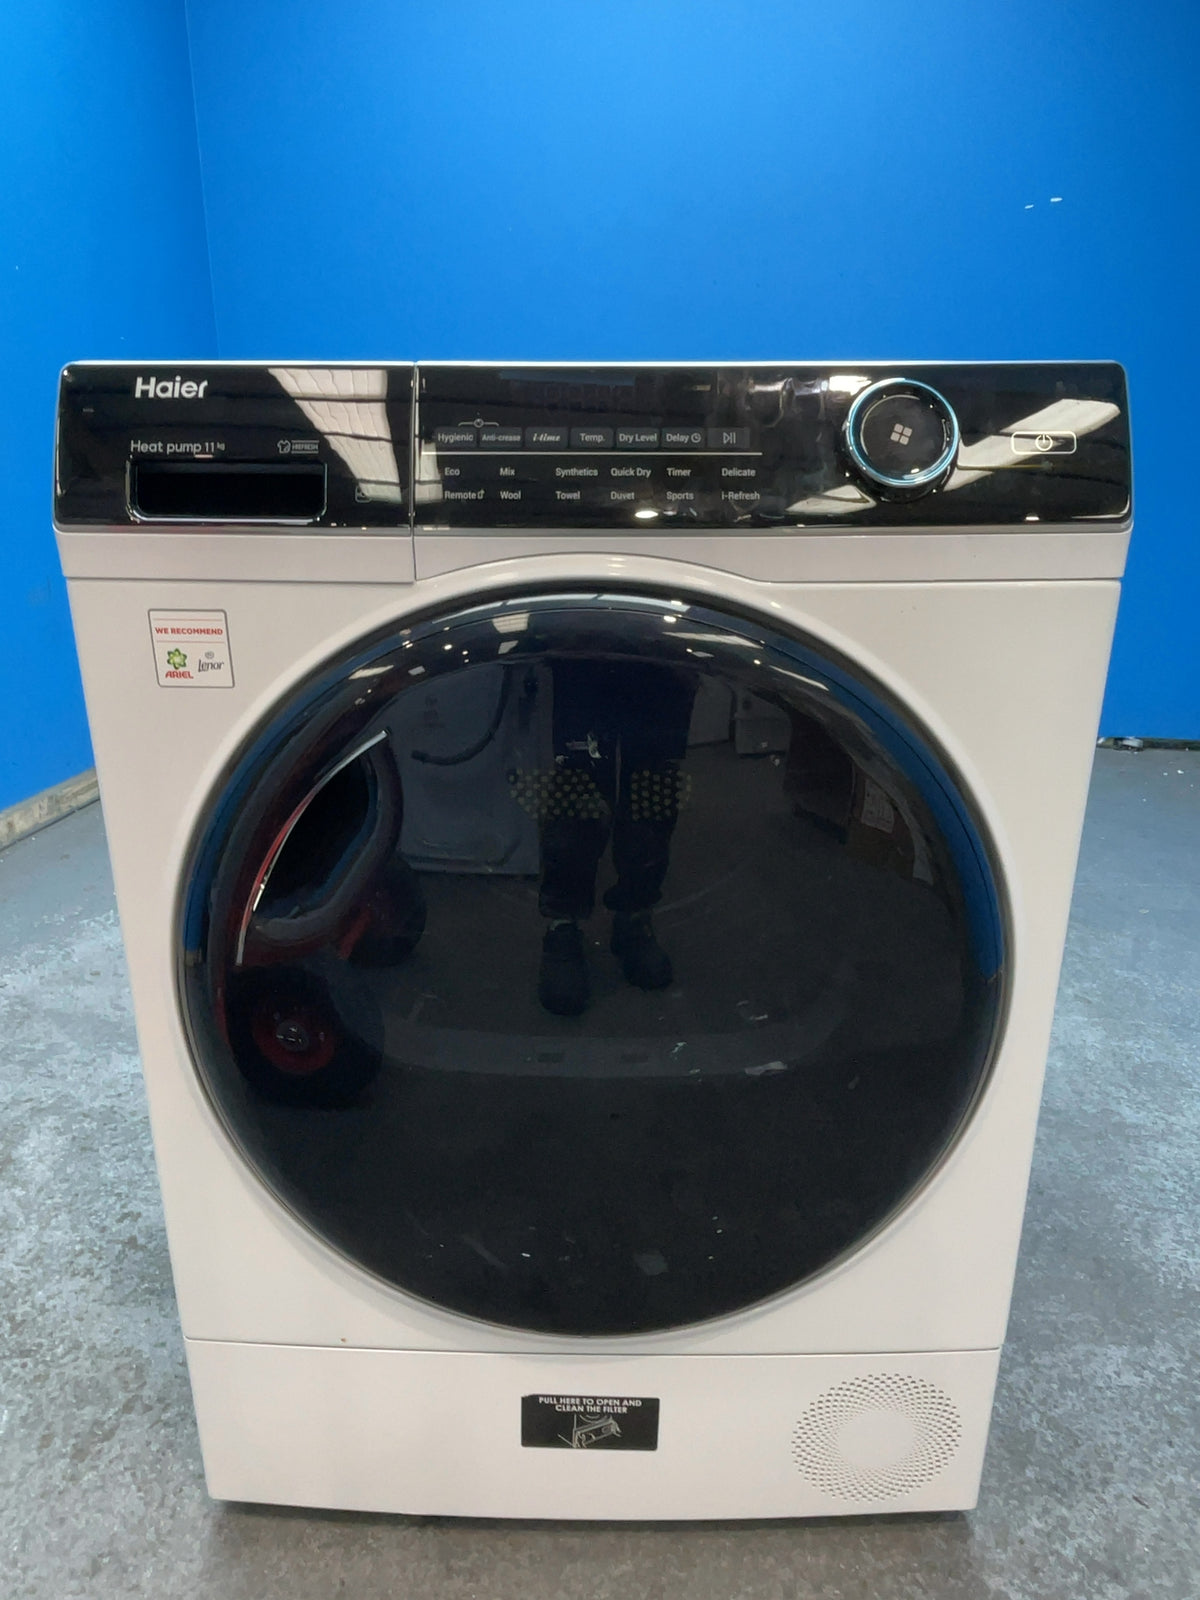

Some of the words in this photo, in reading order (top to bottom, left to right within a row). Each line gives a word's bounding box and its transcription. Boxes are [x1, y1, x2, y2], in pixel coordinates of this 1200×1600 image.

[134, 375, 208, 398] Haier
[437, 433, 474, 443] Hygienic
[482, 434, 521, 442] Anti-crease
[580, 433, 605, 443] Temp.
[619, 433, 633, 443] Dry
[635, 433, 657, 442] Level
[666, 434, 689, 444] Delay
[130, 440, 163, 452] Heat
[166, 442, 202, 455] pump
[204, 441, 215, 452] 11
[444, 467, 460, 476] Eco
[500, 467, 515, 476] Mix
[555, 467, 598, 478] Synthetics
[611, 468, 634, 477] Quick
[636, 468, 651, 478] Dry
[667, 468, 691, 477] Timer
[722, 468, 756, 477] Delicate
[444, 491, 476, 500] Remote
[500, 490, 521, 500] Wool
[556, 491, 581, 500] Towel
[611, 491, 635, 500] Duvet
[667, 491, 694, 501] Sports
[165, 670, 194, 679] ARIEL
[583, 1398, 594, 1406] TO
[597, 1398, 620, 1406] OPEN
[622, 1399, 642, 1407] AND
